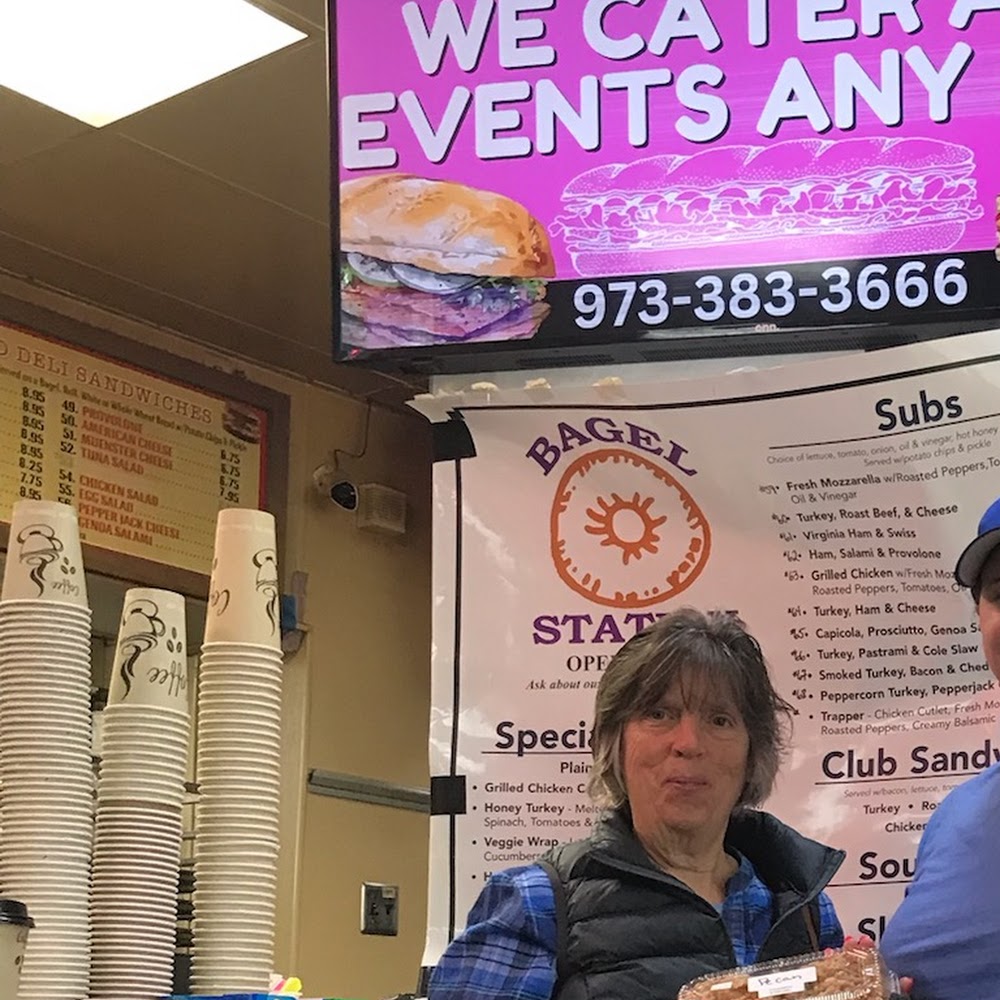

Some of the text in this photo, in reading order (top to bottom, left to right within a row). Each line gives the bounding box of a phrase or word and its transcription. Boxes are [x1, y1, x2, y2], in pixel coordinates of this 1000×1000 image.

[401, 0, 557, 74] WE
[341, 63, 729, 170] EVENTS
[756, 42, 973, 137] ANY
[574, 258, 968, 330] 973-383-3666
[17, 346, 68, 376] DELI
[76, 366, 213, 424] SANDWICHES
[875, 390, 963, 432] Subs
[81, 420, 137, 446] AMERICAN
[526, 417, 698, 476] BAGEL
[766, 455, 794, 465] Choice
[806, 451, 836, 462] lettuce,
[837, 448, 869, 458] tomato,
[972, 424, 998, 438] honey
[864, 438, 992, 468] Served w/potato chips pickle
[81, 447, 144, 475] TUNA SALAD
[786, 465, 939, 493] Fresh Mozzarella w/Roasted
[79, 489, 134, 513] EGG SALAD
[80, 475, 159, 507] CHICKEN SALAD
[791, 491, 857, 504] Oil Vinegar
[79, 503, 118, 525] PEPPER
[796, 505, 958, 522] Turkey, Roast Beef, Cheese
[802, 528, 917, 542] Virginia Ham Swiss
[809, 547, 941, 560] Ham, Salami Provolone
[811, 567, 934, 581] Grilled Chicken w/Fresh
[812, 582, 949, 596] Roasted Peppers, Tomatoes,
[814, 602, 936, 618] Turkey, Ham Cheese
[815, 624, 967, 641] Capicola, Prosciutto, Genoa
[817, 644, 978, 661] Turkey, Pastrami Cole Slaw
[148, 660, 188, 697] offee
[819, 665, 943, 680] Smoked Turkey, Bacon
[526, 678, 581, 690] Ask about
[820, 680, 995, 703] Peppercorn Turkey, Pepperjack
[821, 702, 981, 722] Trapper Chicken Cutlet, Fresh
[821, 714, 996, 736] Roasted Peppers, Creamy Balsamic
[495, 721, 594, 757] Speci
[822, 747, 898, 780] Club
[484, 782, 573, 794] Grilled Chicken
[843, 784, 941, 799] Served w/bacon, lettuce,
[484, 802, 565, 816] Honey Turkey
[863, 804, 901, 815] Turkey
[484, 817, 581, 829] Spinach, Tomatoes
[484, 836, 559, 849] Veggie Wrap
